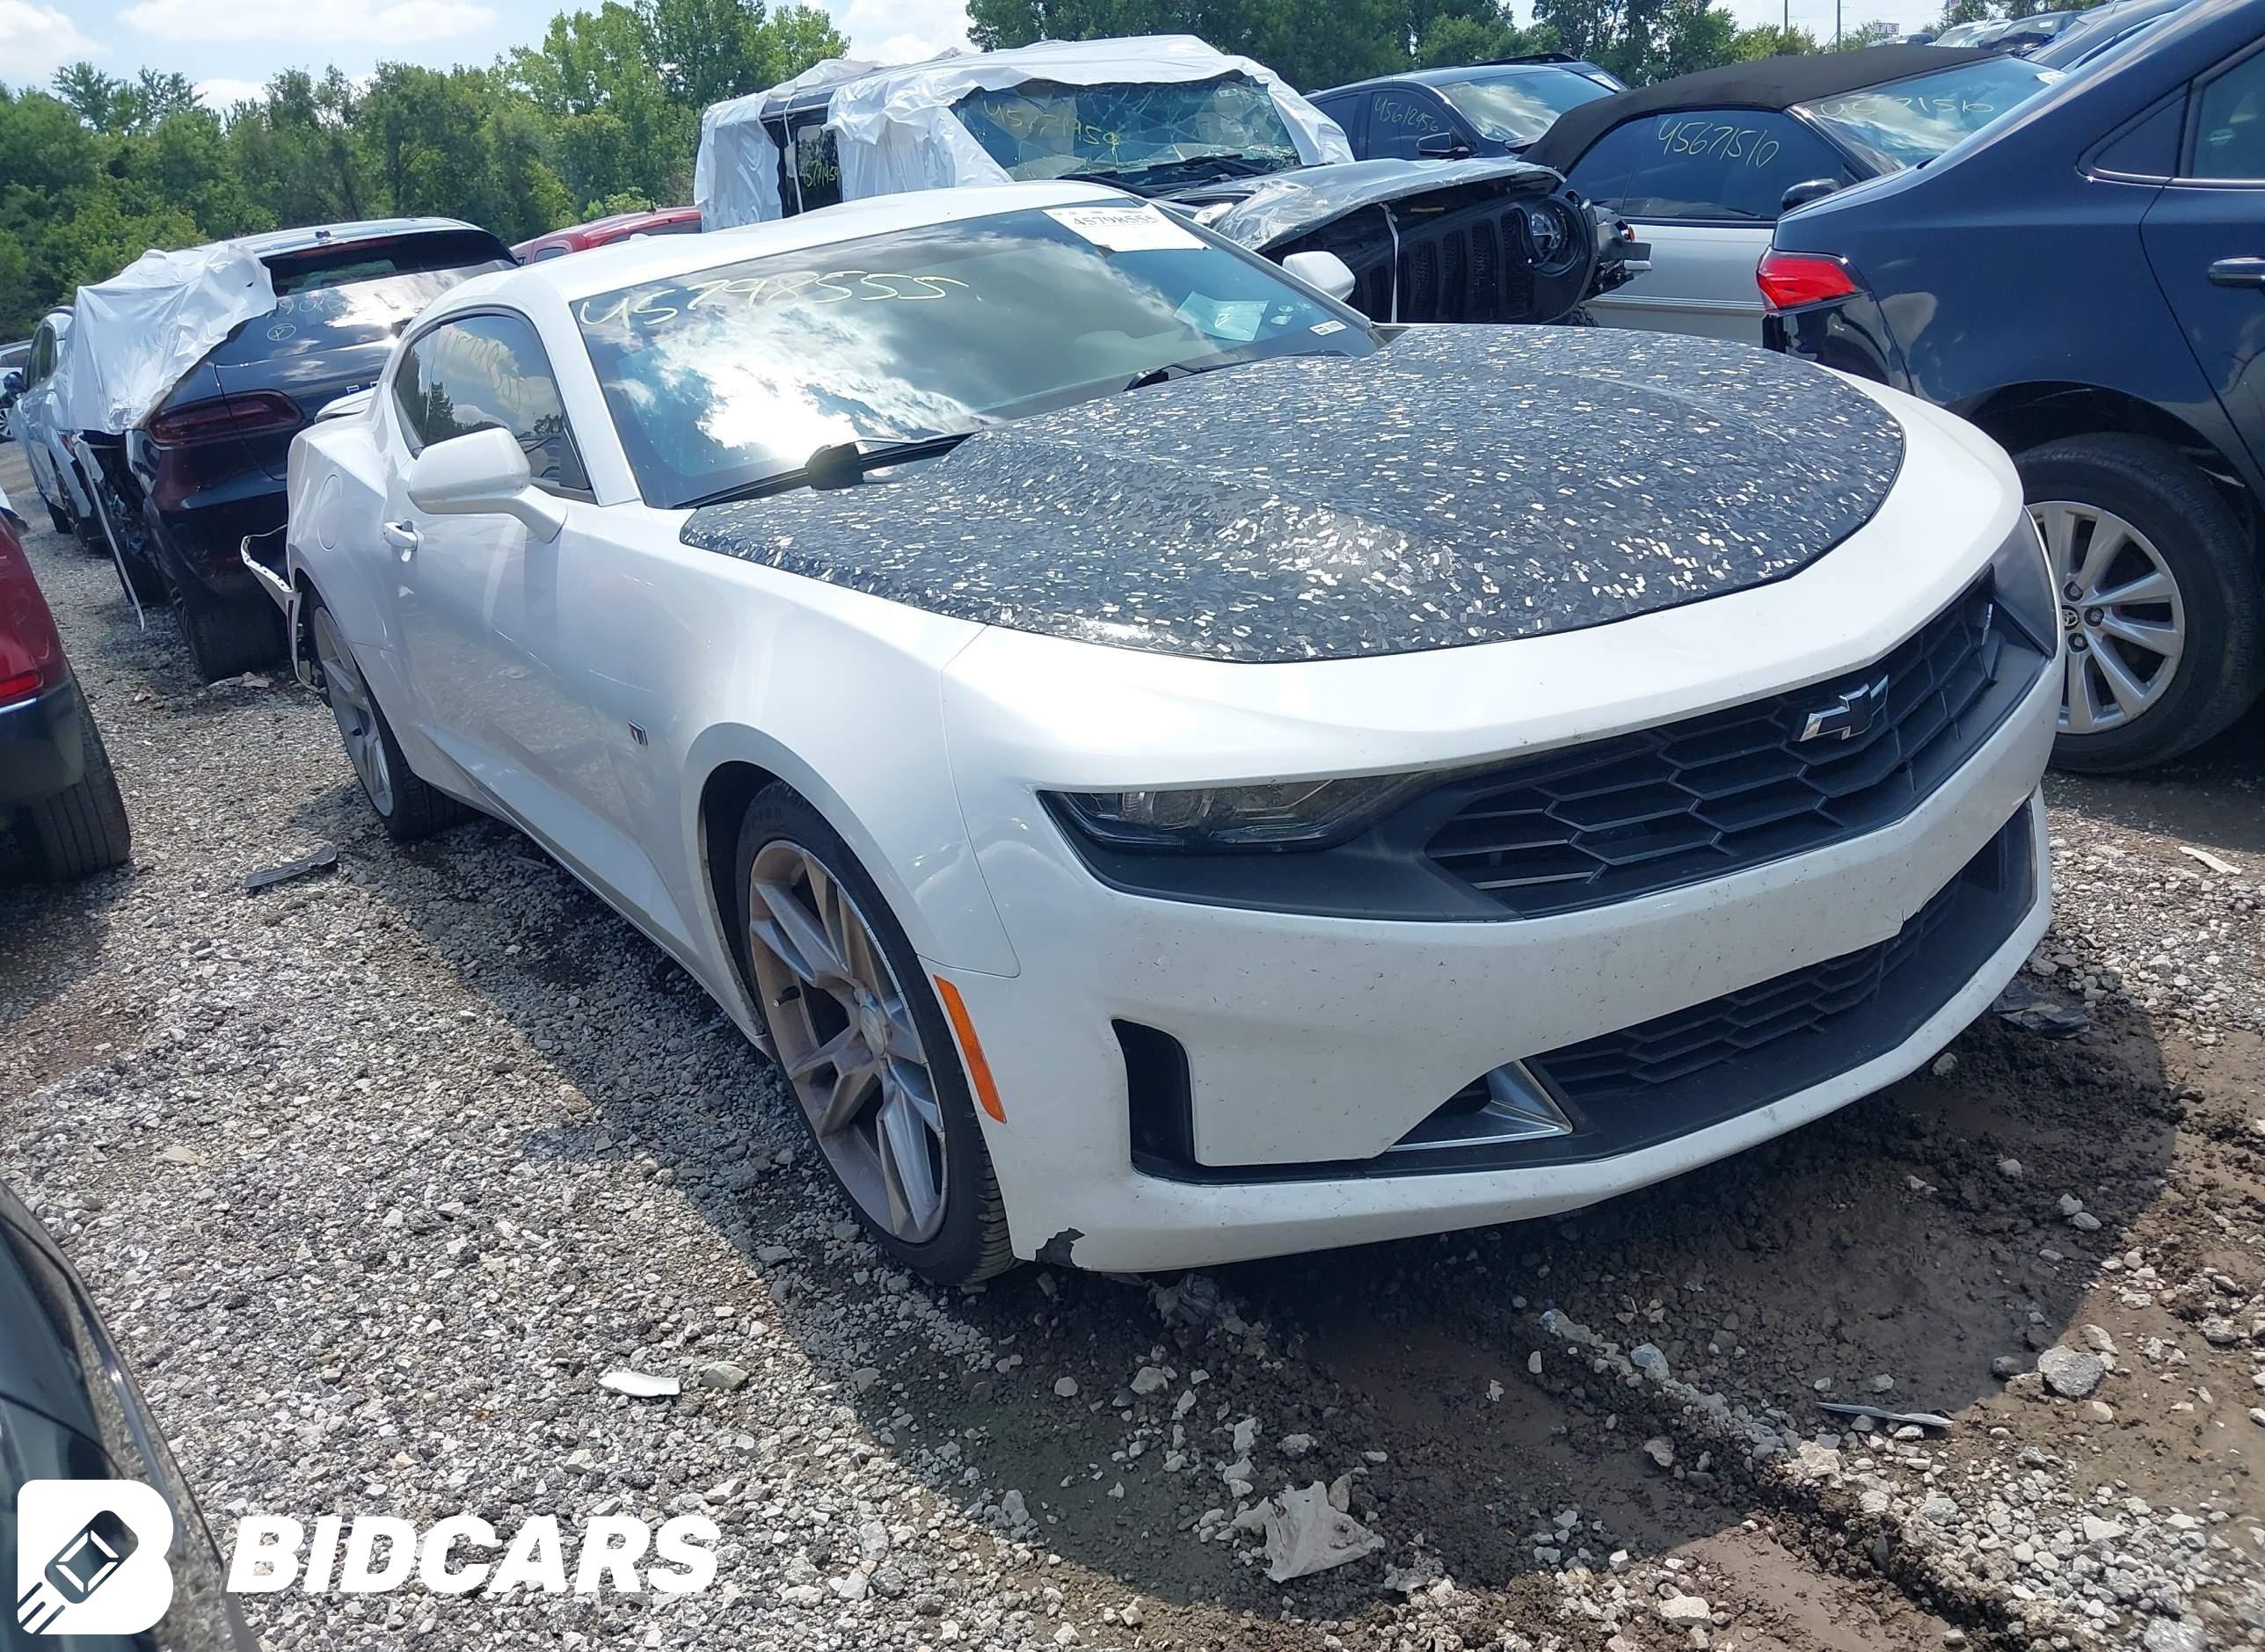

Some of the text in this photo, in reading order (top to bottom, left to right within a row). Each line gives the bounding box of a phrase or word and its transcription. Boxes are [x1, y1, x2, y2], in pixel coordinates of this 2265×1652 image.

[1820, 96, 1994, 117] 4571510
[1658, 116, 1780, 169] 45671510
[579, 270, 970, 329] 45798555
